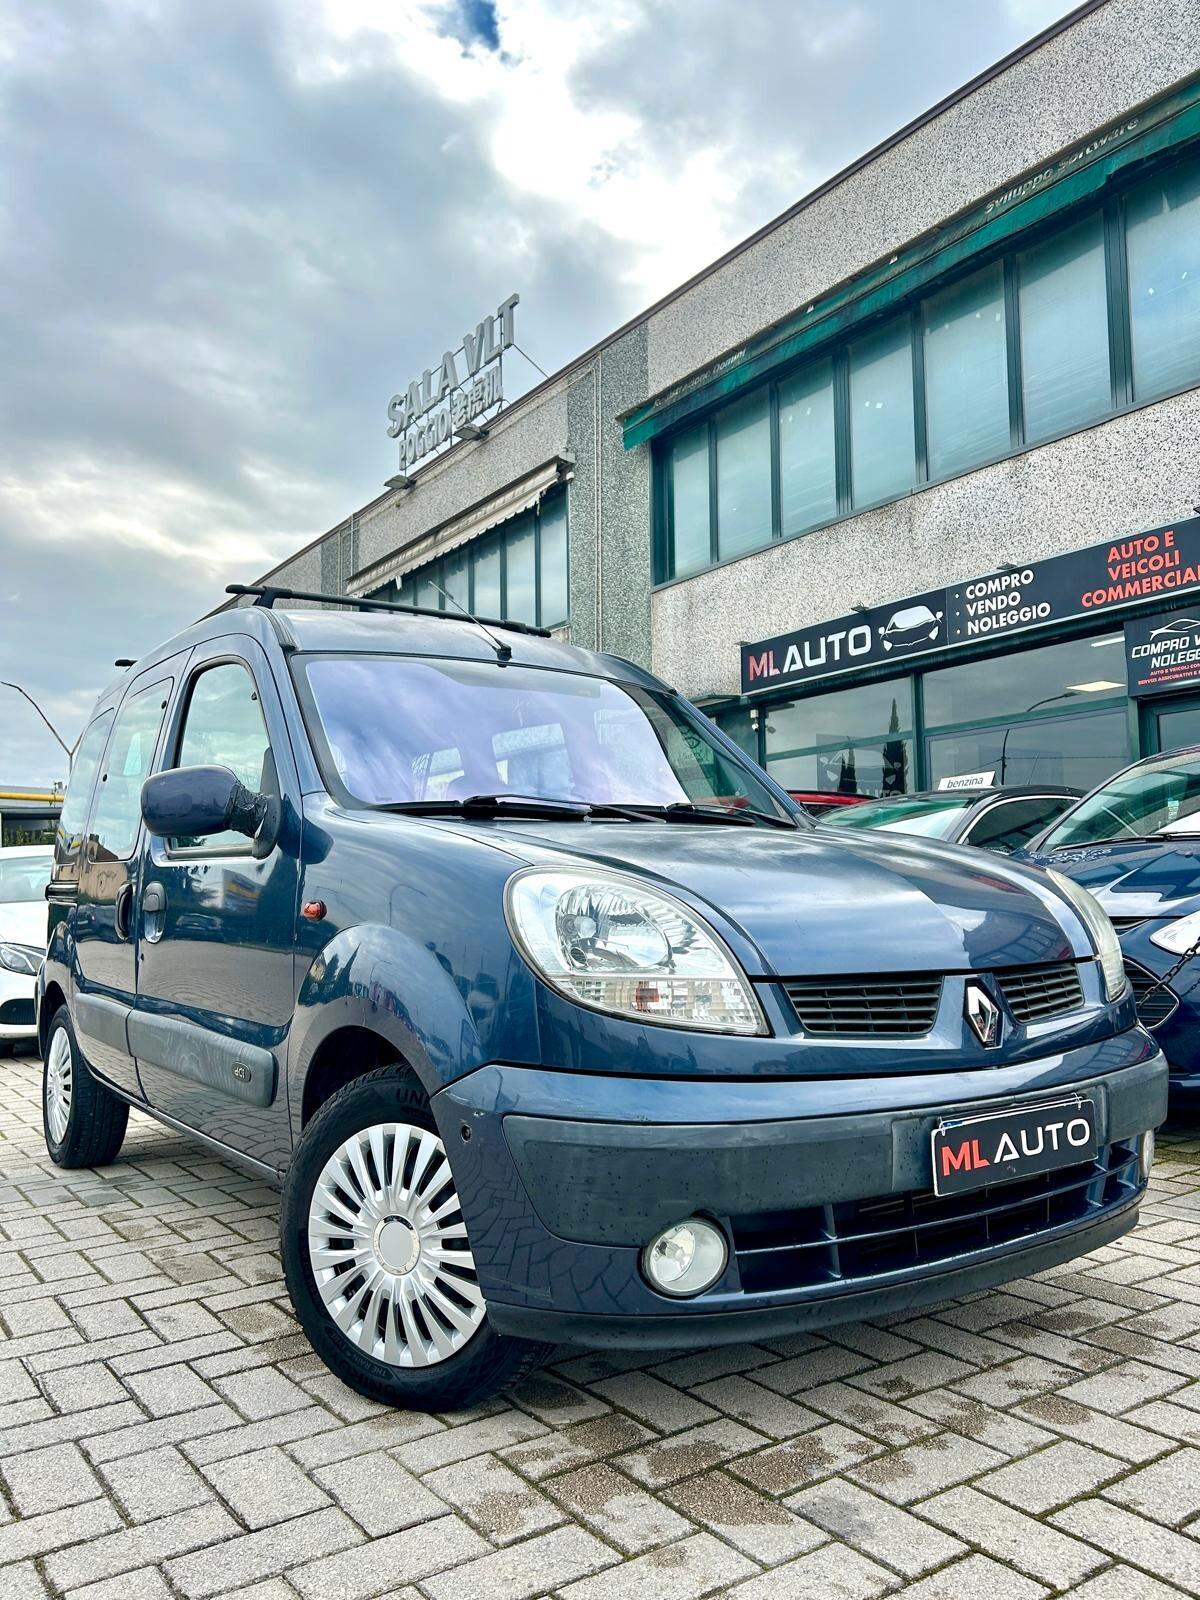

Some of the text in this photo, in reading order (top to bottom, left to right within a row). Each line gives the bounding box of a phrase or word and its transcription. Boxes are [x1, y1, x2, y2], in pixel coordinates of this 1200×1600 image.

[386, 293, 520, 438] SALA VLT
[398, 408, 452, 471] POGGIO
[1107, 530, 1175, 563] AUTO E
[1107, 550, 1181, 582] VEICOLI
[965, 569, 1034, 600] COMPRO
[966, 591, 1021, 617] VENDO
[967, 602, 1051, 636] NOLEGGIO
[1131, 636, 1190, 659] COMPRO
[946, 777, 984, 789] benzina
